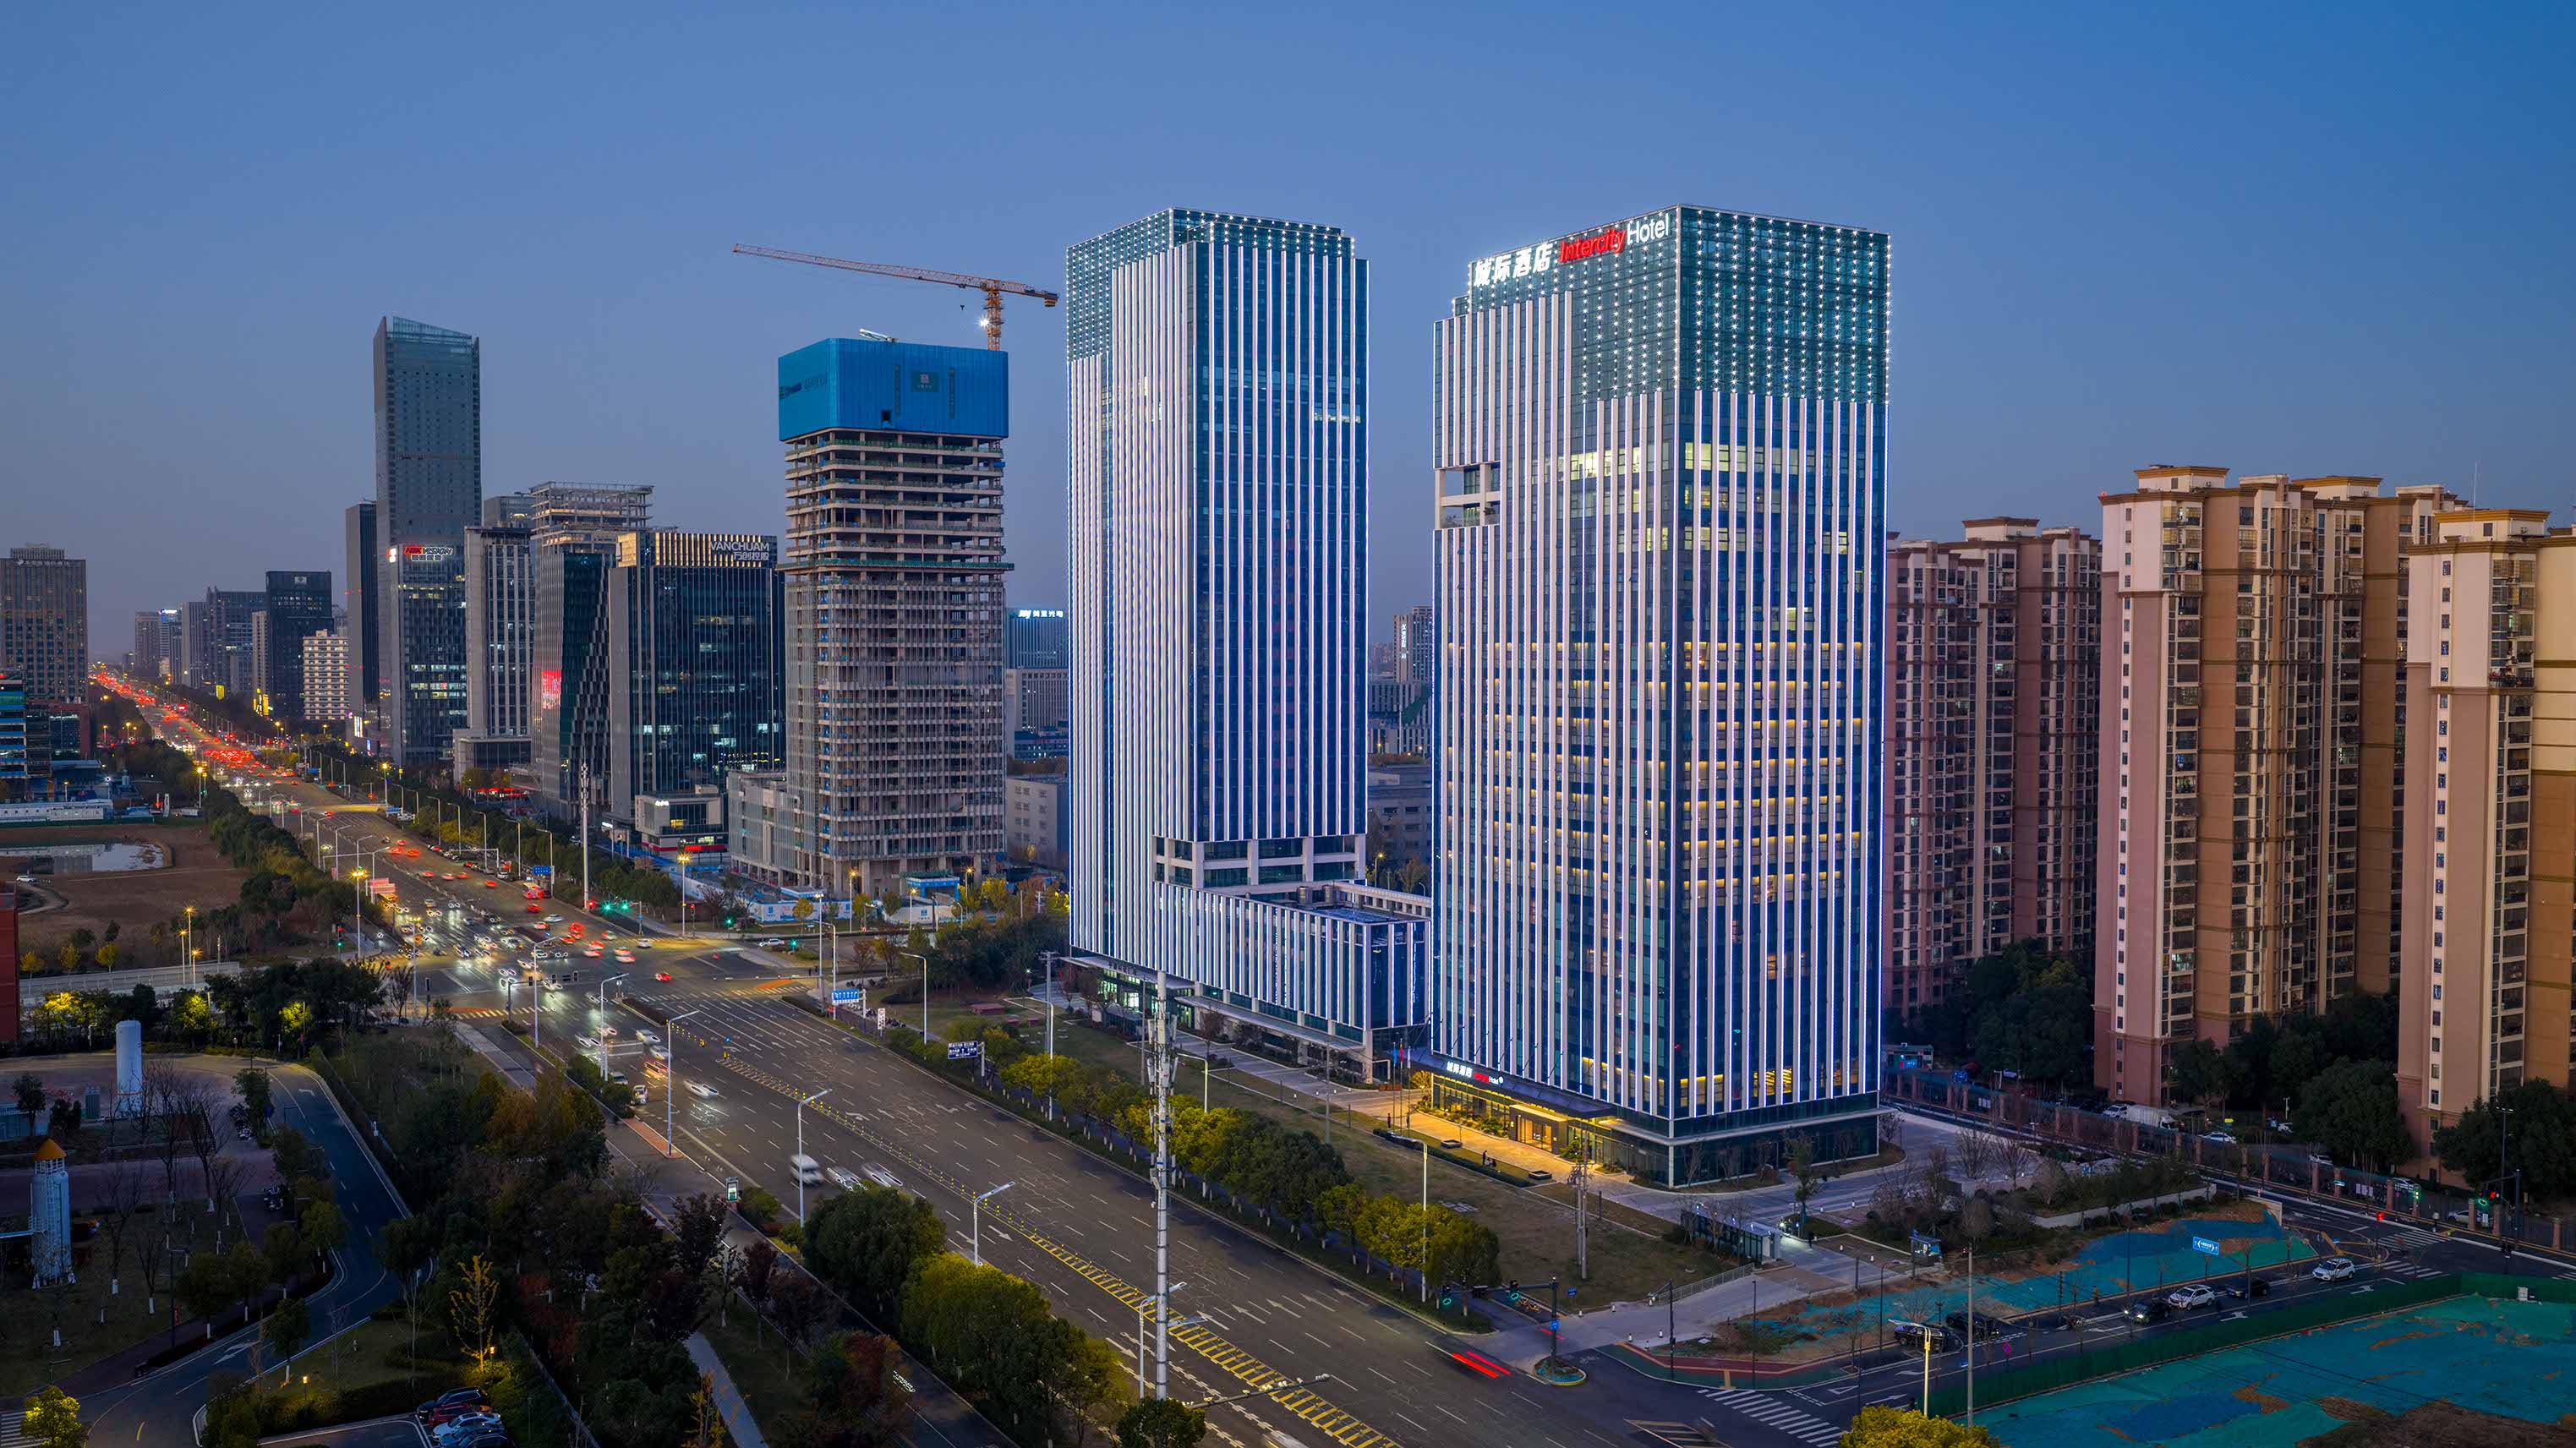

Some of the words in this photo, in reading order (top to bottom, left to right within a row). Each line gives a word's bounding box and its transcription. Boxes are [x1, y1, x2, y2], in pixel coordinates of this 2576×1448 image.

[1474, 242, 1554, 287] 城际酒店
[1559, 227, 1627, 264] Intercity
[1627, 213, 1669, 245] Hotel
[710, 541, 769, 551] VANCHUAM
